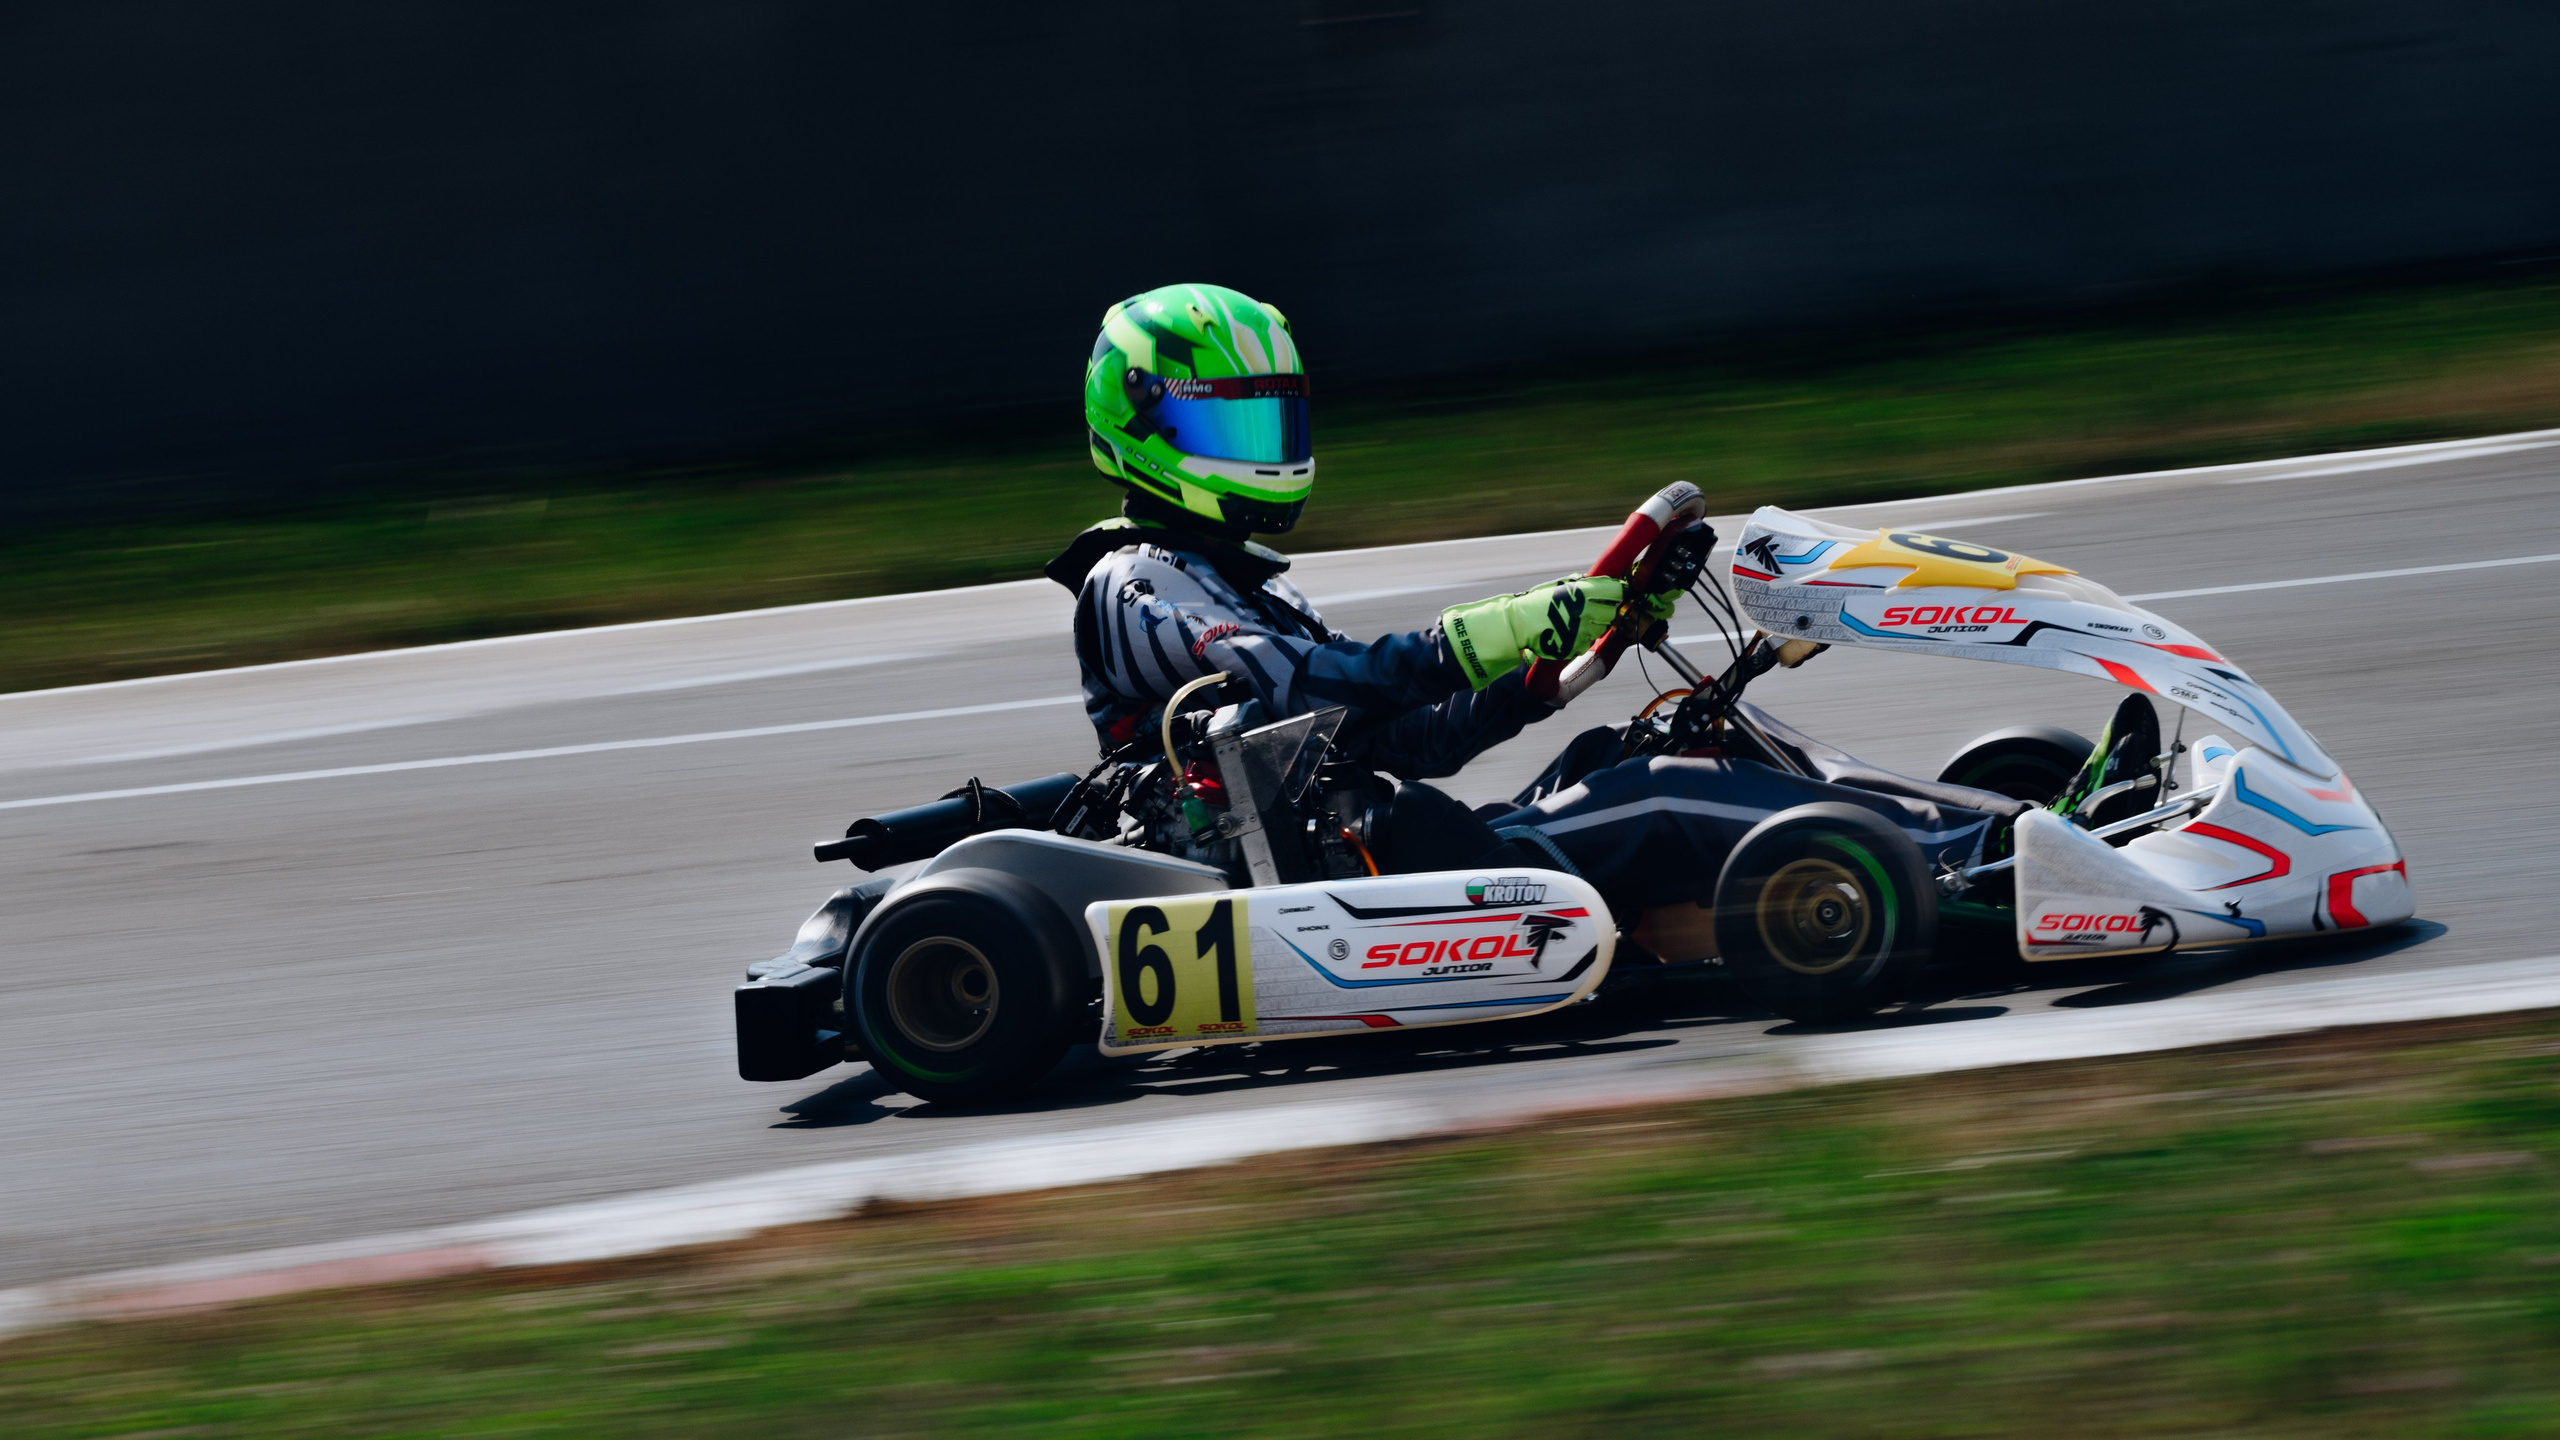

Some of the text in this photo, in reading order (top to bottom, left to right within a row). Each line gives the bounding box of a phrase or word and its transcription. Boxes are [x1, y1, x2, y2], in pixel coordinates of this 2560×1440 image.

[1878, 607, 2029, 626] SOKOL
[1927, 625, 1989, 634] JUNIOR
[1460, 638, 1488, 679] SERVICE
[1482, 884, 1546, 903] KROTOV
[2035, 914, 2147, 932] SOKOL
[1361, 934, 1536, 969] SOKOL
[1118, 899, 1242, 1027] 61
[1422, 962, 1493, 976] JUNIOR
